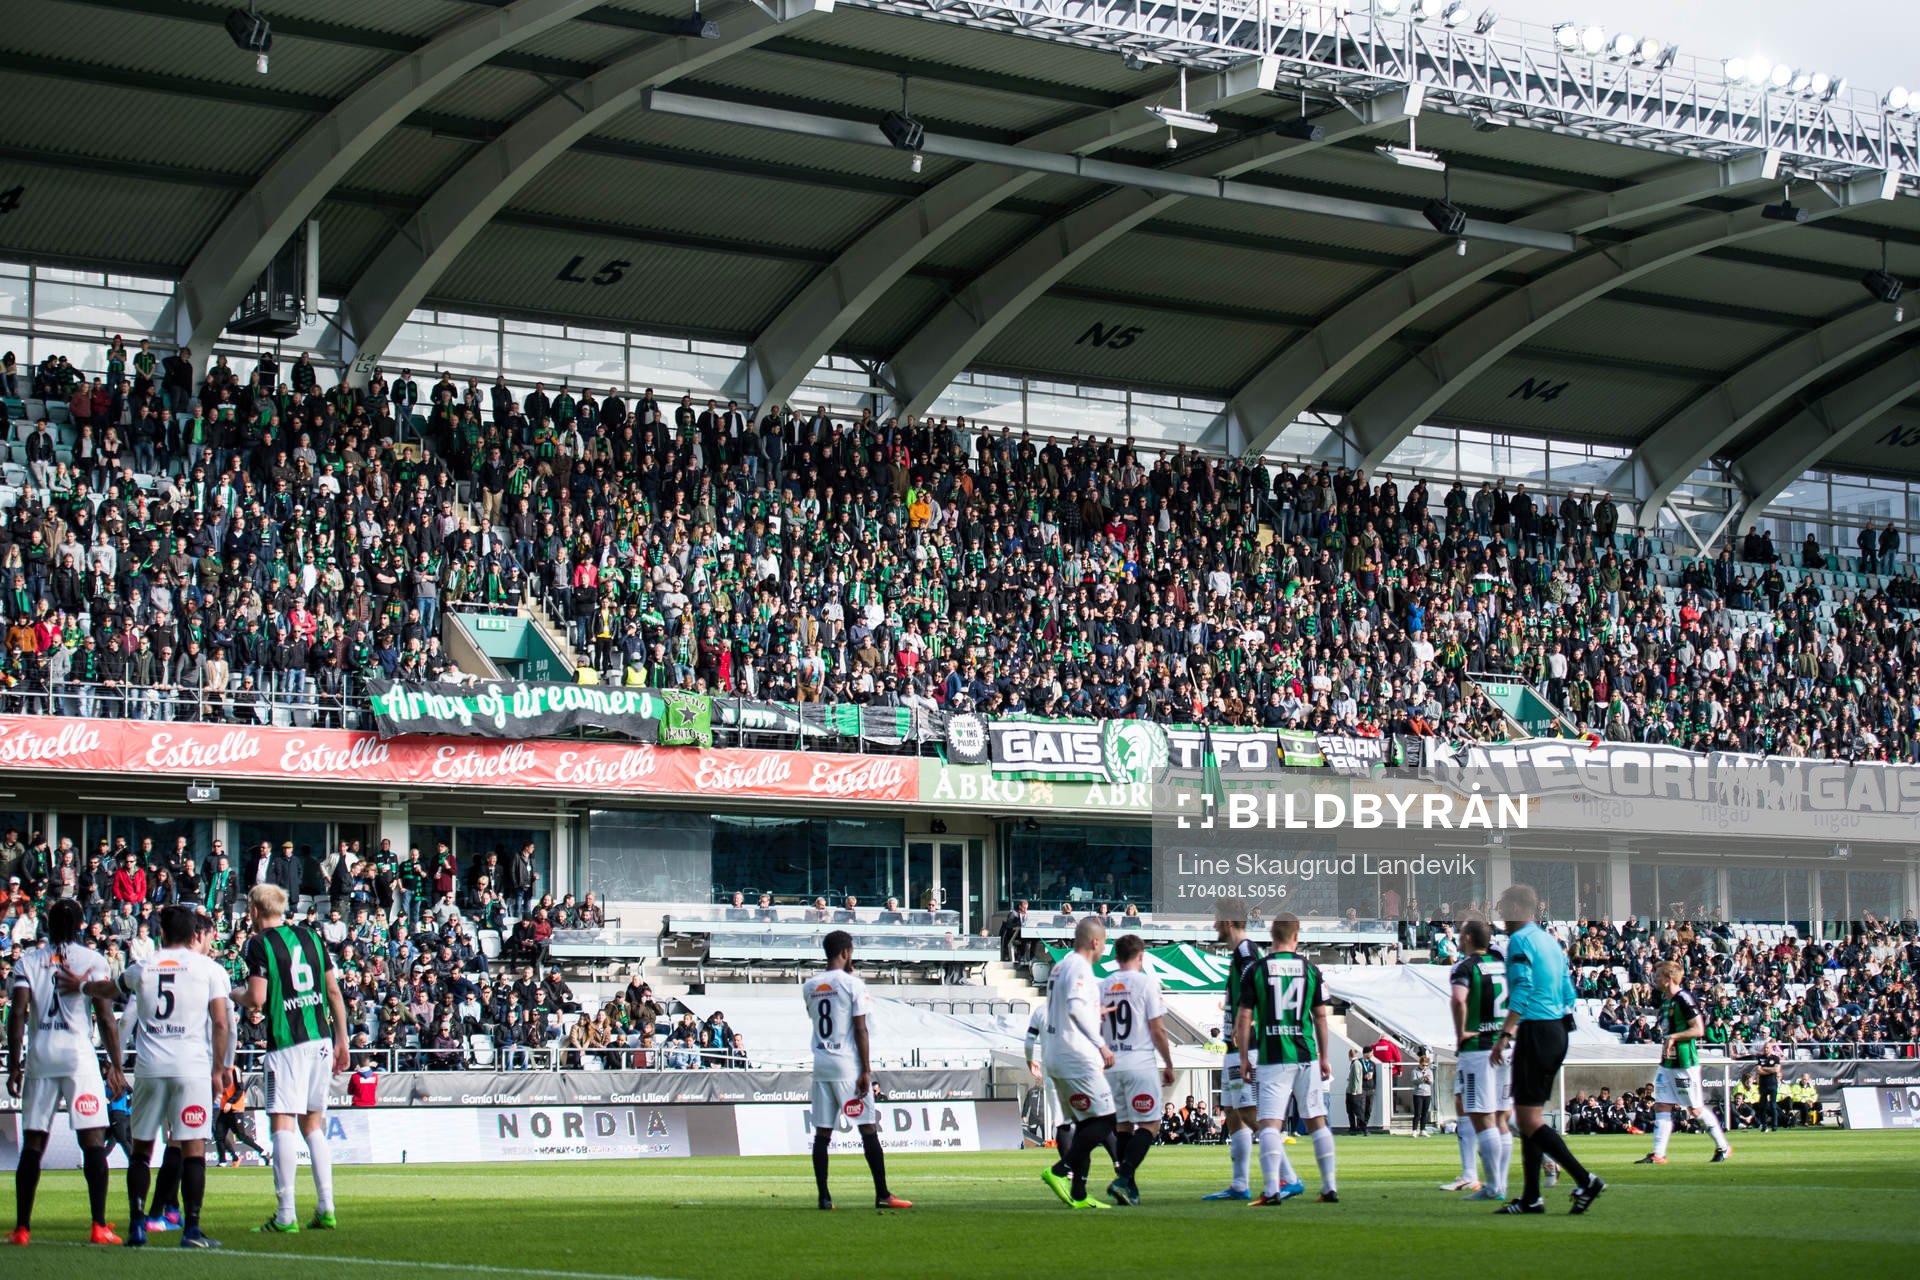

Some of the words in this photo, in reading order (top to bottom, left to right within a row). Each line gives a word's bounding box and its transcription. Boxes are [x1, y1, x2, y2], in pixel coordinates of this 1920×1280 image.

[555, 255, 631, 286] L5
[1073, 322, 1145, 350] N5
[354, 362, 370, 374] L5
[1505, 377, 1571, 402] N4
[381, 683, 471, 726] Army
[477, 683, 507, 729] of
[513, 683, 653, 719] dreamers
[146, 730, 260, 767] Estrella
[280, 735, 390, 772] Estrella
[432, 743, 536, 778] Estrella
[1002, 731, 1102, 765] GAIS
[1173, 739, 1268, 771] TFO
[1316, 736, 1382, 759] SEDAN
[554, 750, 656, 783] Estrella
[693, 754, 792, 788] Estrella
[808, 759, 903, 793] Estrella
[197, 789, 210, 798] K3
[933, 768, 1025, 802] ÅBRO
[290, 945, 314, 992] 6
[155, 974, 175, 1020] 5
[1268, 976, 1304, 1020] 14
[818, 998, 833, 1039] 8
[1105, 1000, 1132, 1041] 19
[461, 1094, 492, 1105] Gamla
[494, 1094, 520, 1104] Ullevi
[610, 1093, 641, 1103] Gamla
[642, 1093, 669, 1103] Ullevi
[753, 1091, 782, 1101] Gamla
[783, 1091, 809, 1101] Ullevi
[889, 1090, 917, 1100] Gamla
[918, 1090, 942, 1100] Ullevi
[498, 1111, 670, 1138] NORDIA
